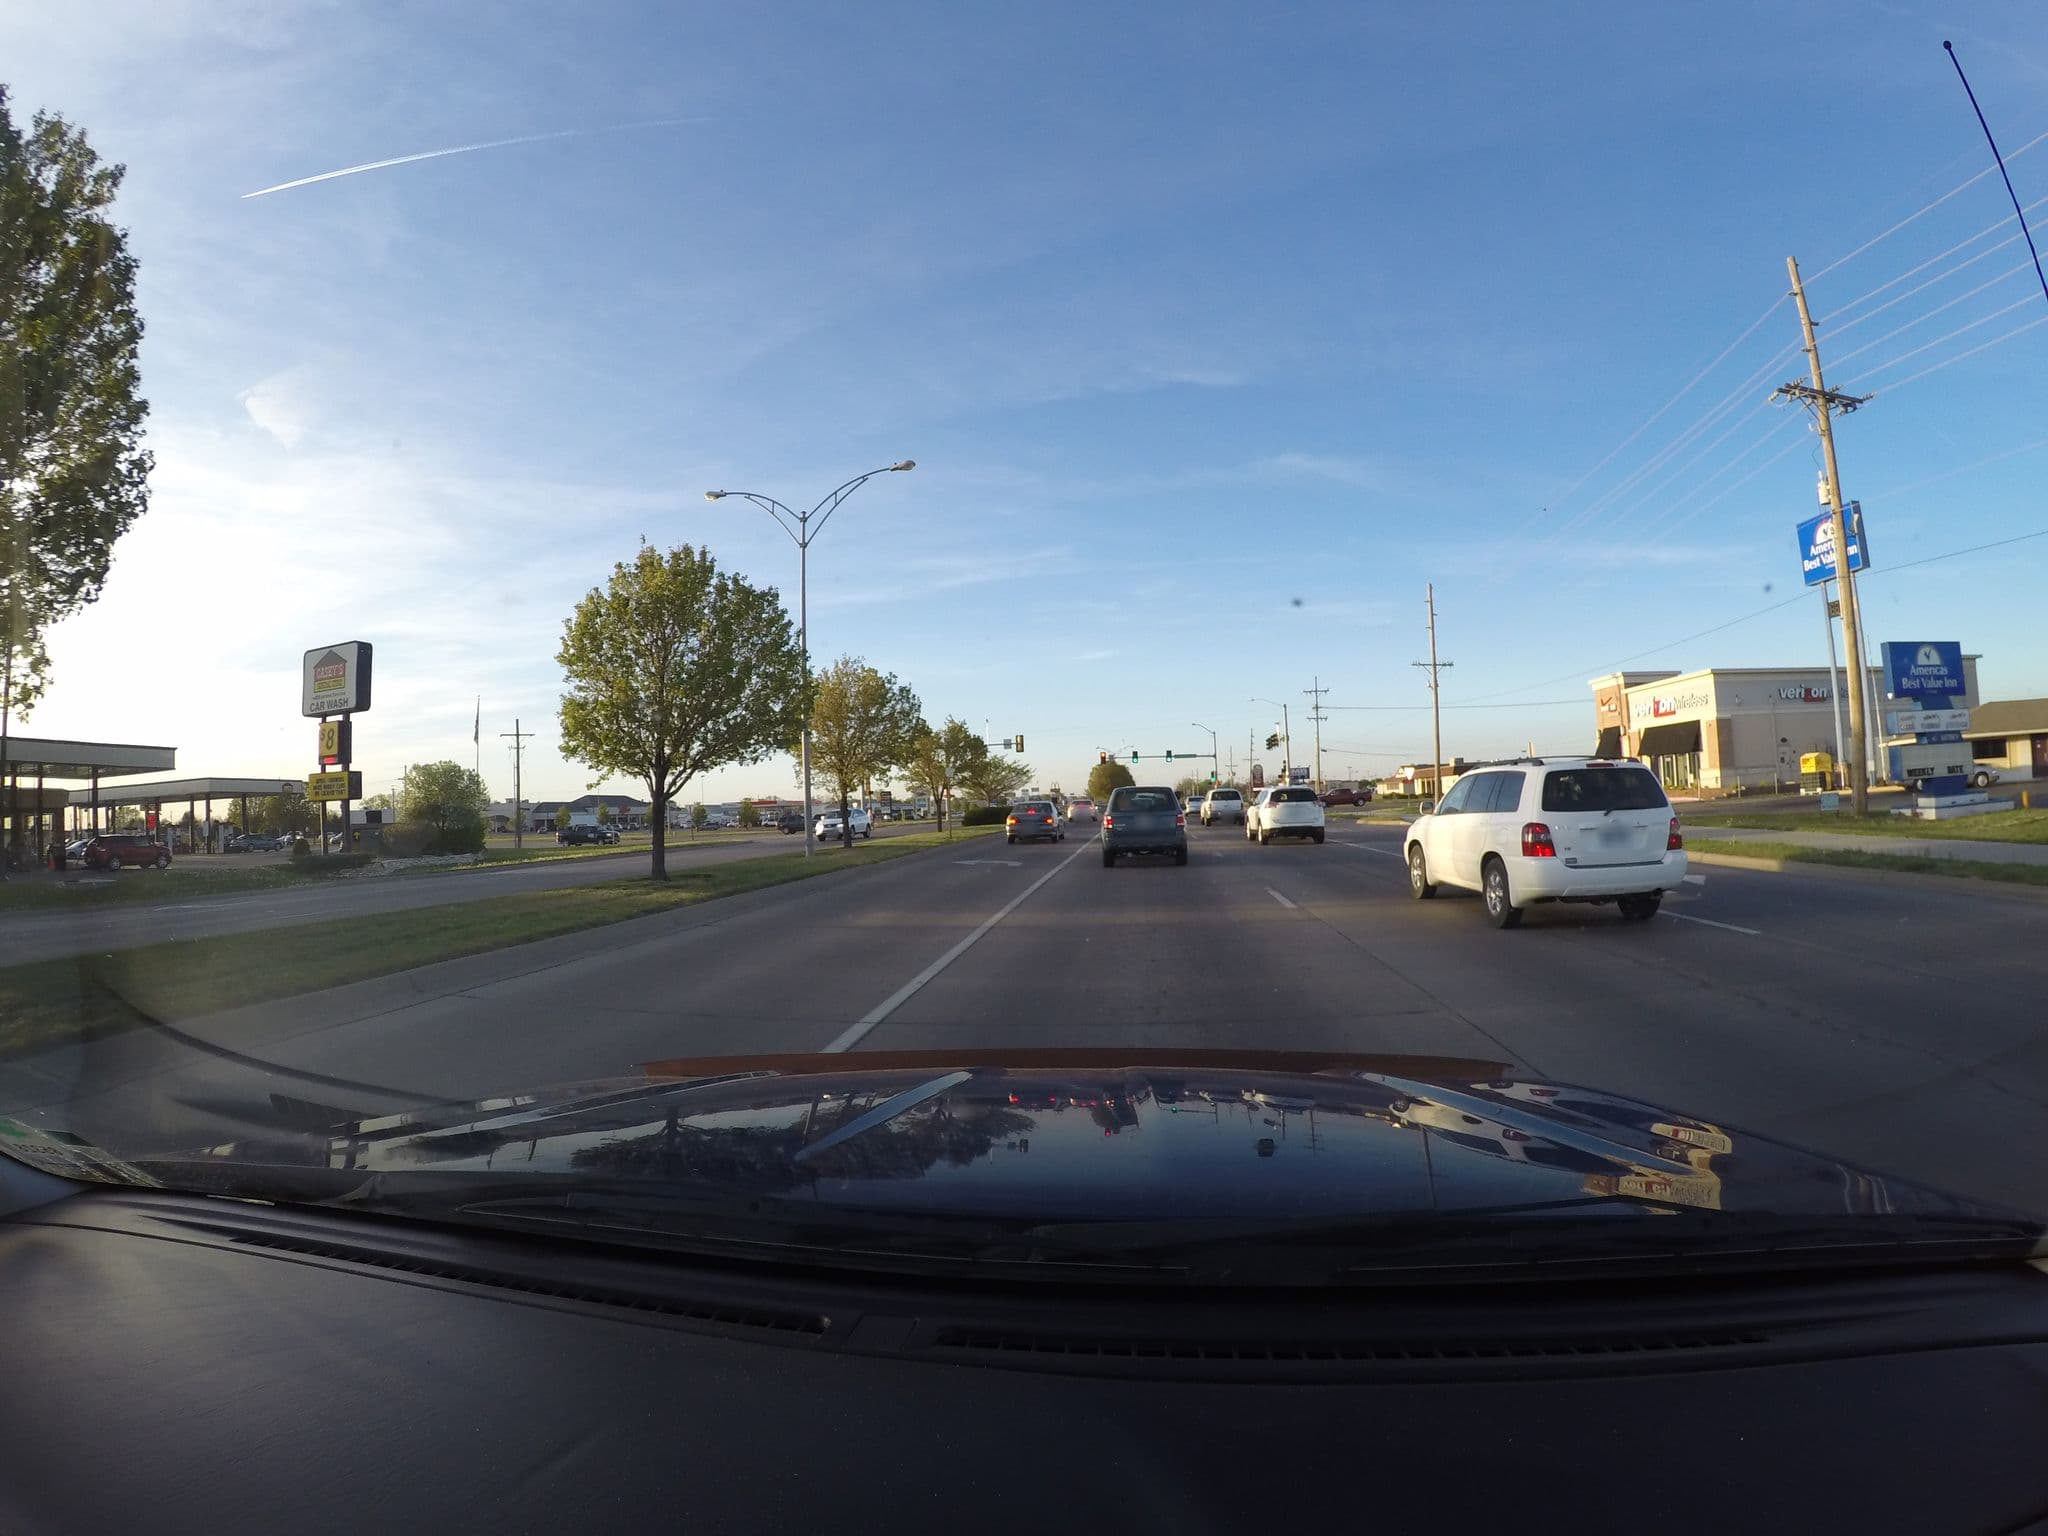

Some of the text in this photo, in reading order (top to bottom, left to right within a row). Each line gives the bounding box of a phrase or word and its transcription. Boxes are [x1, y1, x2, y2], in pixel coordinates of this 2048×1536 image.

[1810, 541, 1834, 556] Amer
[1803, 558, 1820, 571] Best
[1820, 550, 1835, 564] Val
[1910, 664, 1948, 676] Americas
[1902, 676, 1958, 689] Best Value Inn
[1778, 683, 1828, 703] verizon
[310, 697, 348, 712] CAR WASH
[1906, 766, 1935, 778] WEEKLY
